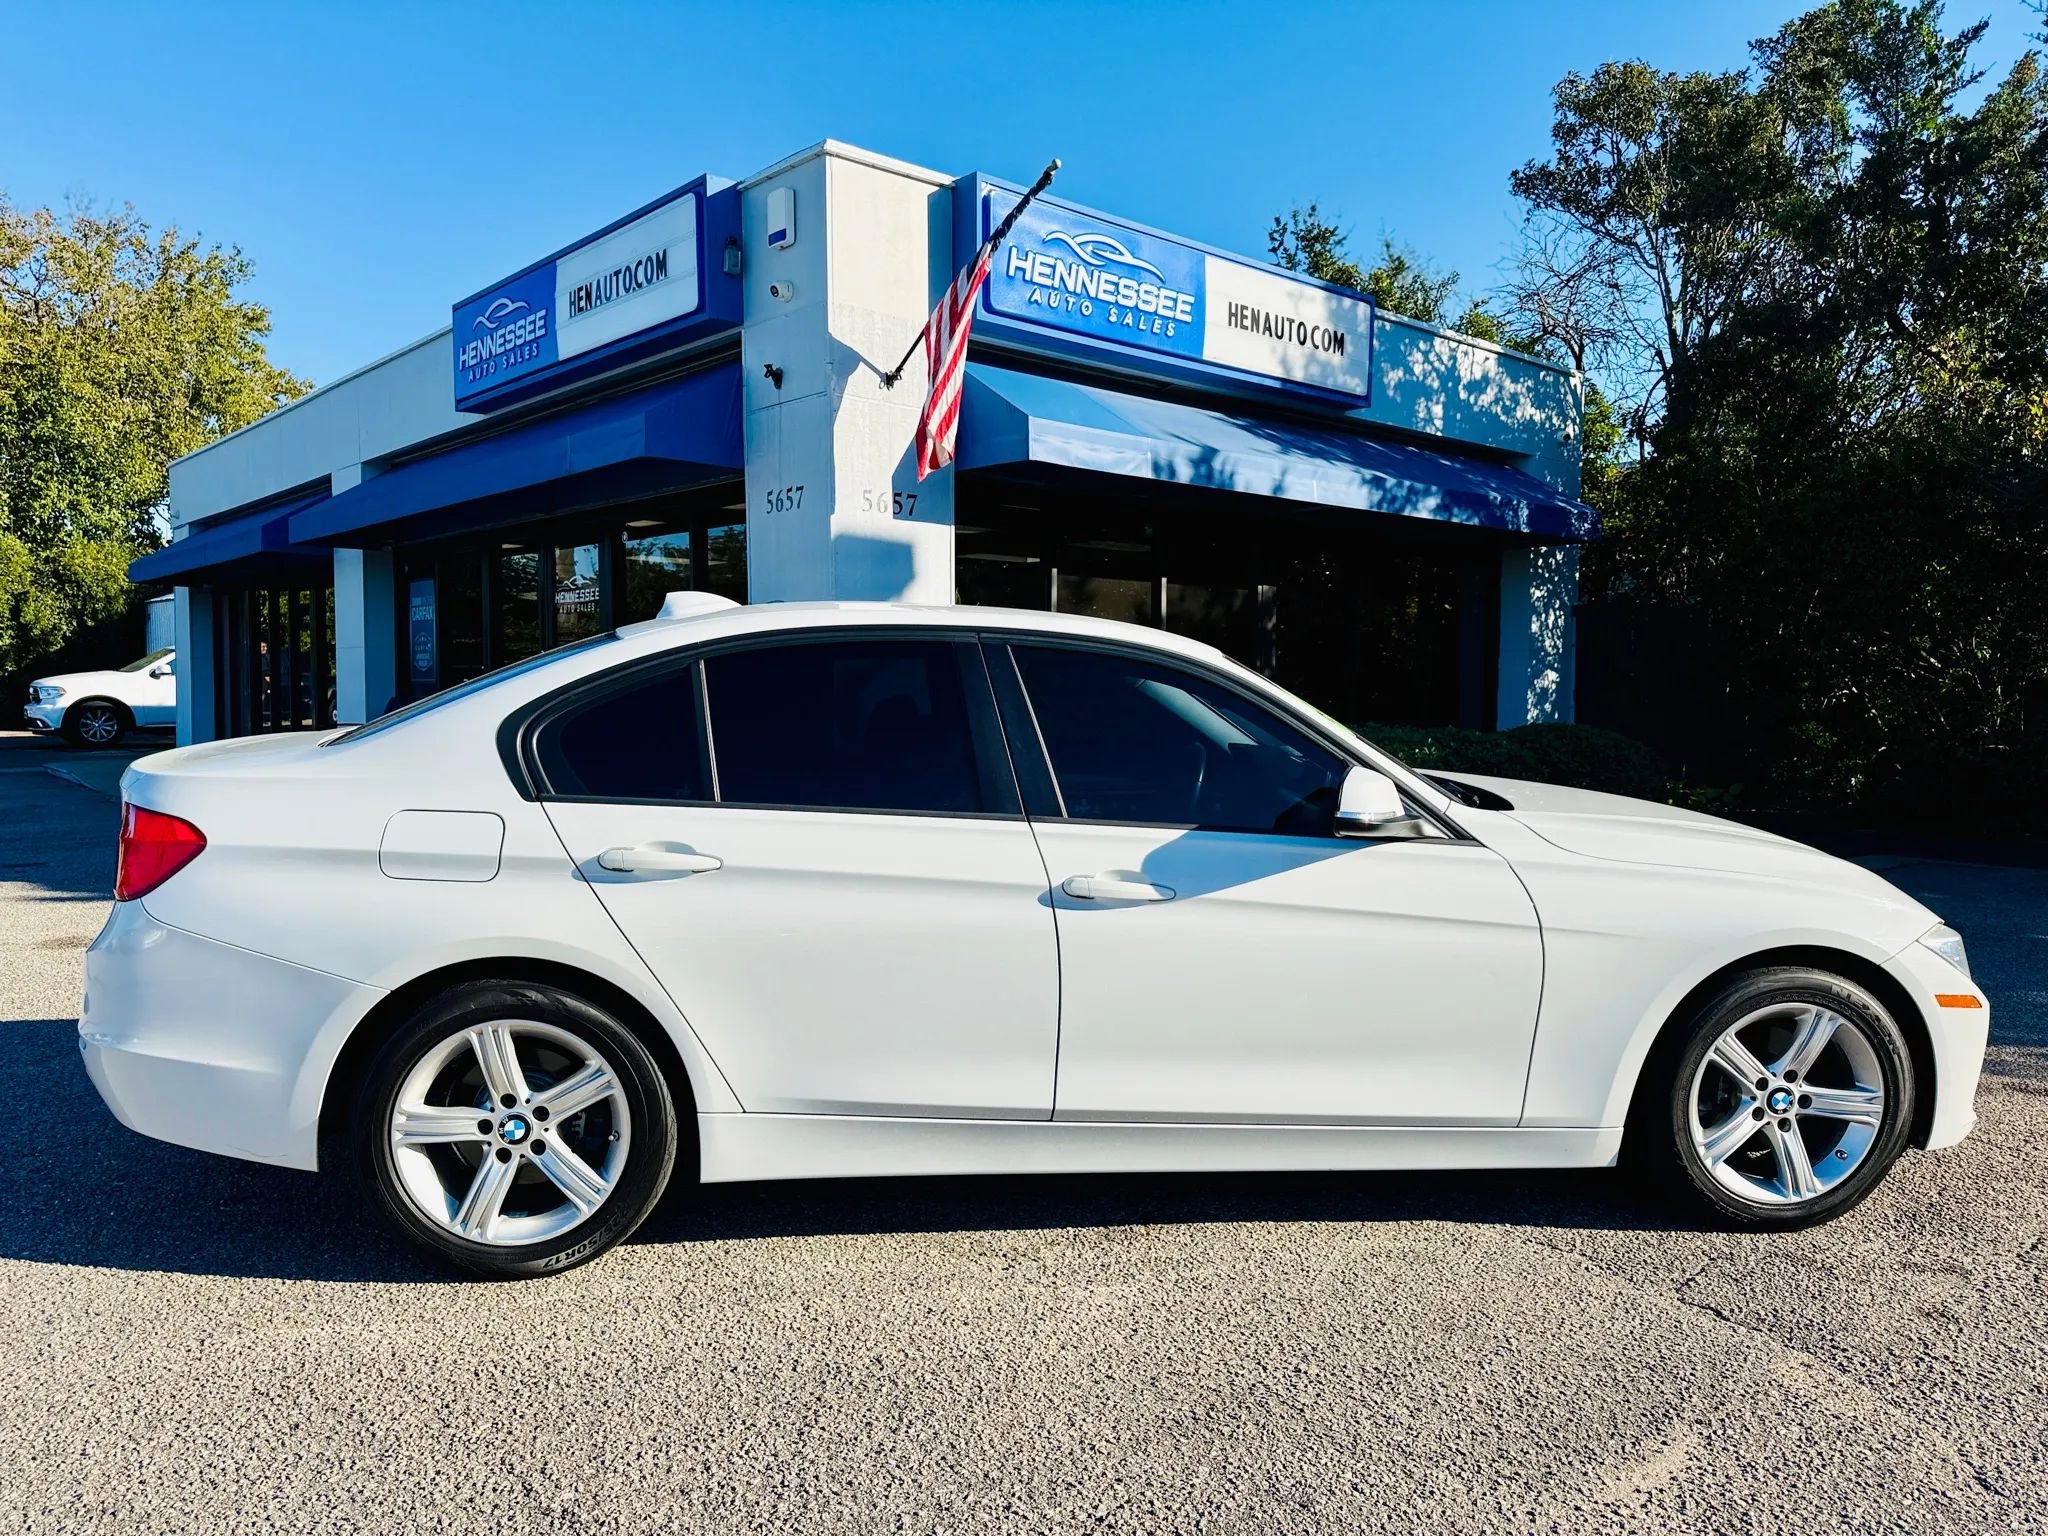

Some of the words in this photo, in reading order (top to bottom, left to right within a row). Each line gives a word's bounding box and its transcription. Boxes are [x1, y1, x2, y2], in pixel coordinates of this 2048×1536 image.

[1007, 245, 1195, 324] HENNESSEE
[1030, 286, 1093, 317] AUTO
[1107, 305, 1177, 338] SALES
[459, 308, 546, 371] HENNESSEE
[468, 361, 496, 382] AUTO
[502, 343, 538, 369] SALES
[766, 485, 804, 514] 5657
[862, 489, 918, 516] 5657
[555, 587, 600, 604] HENNESSEE
[560, 604, 575, 613] AUTO
[576, 602, 595, 612] SALES
